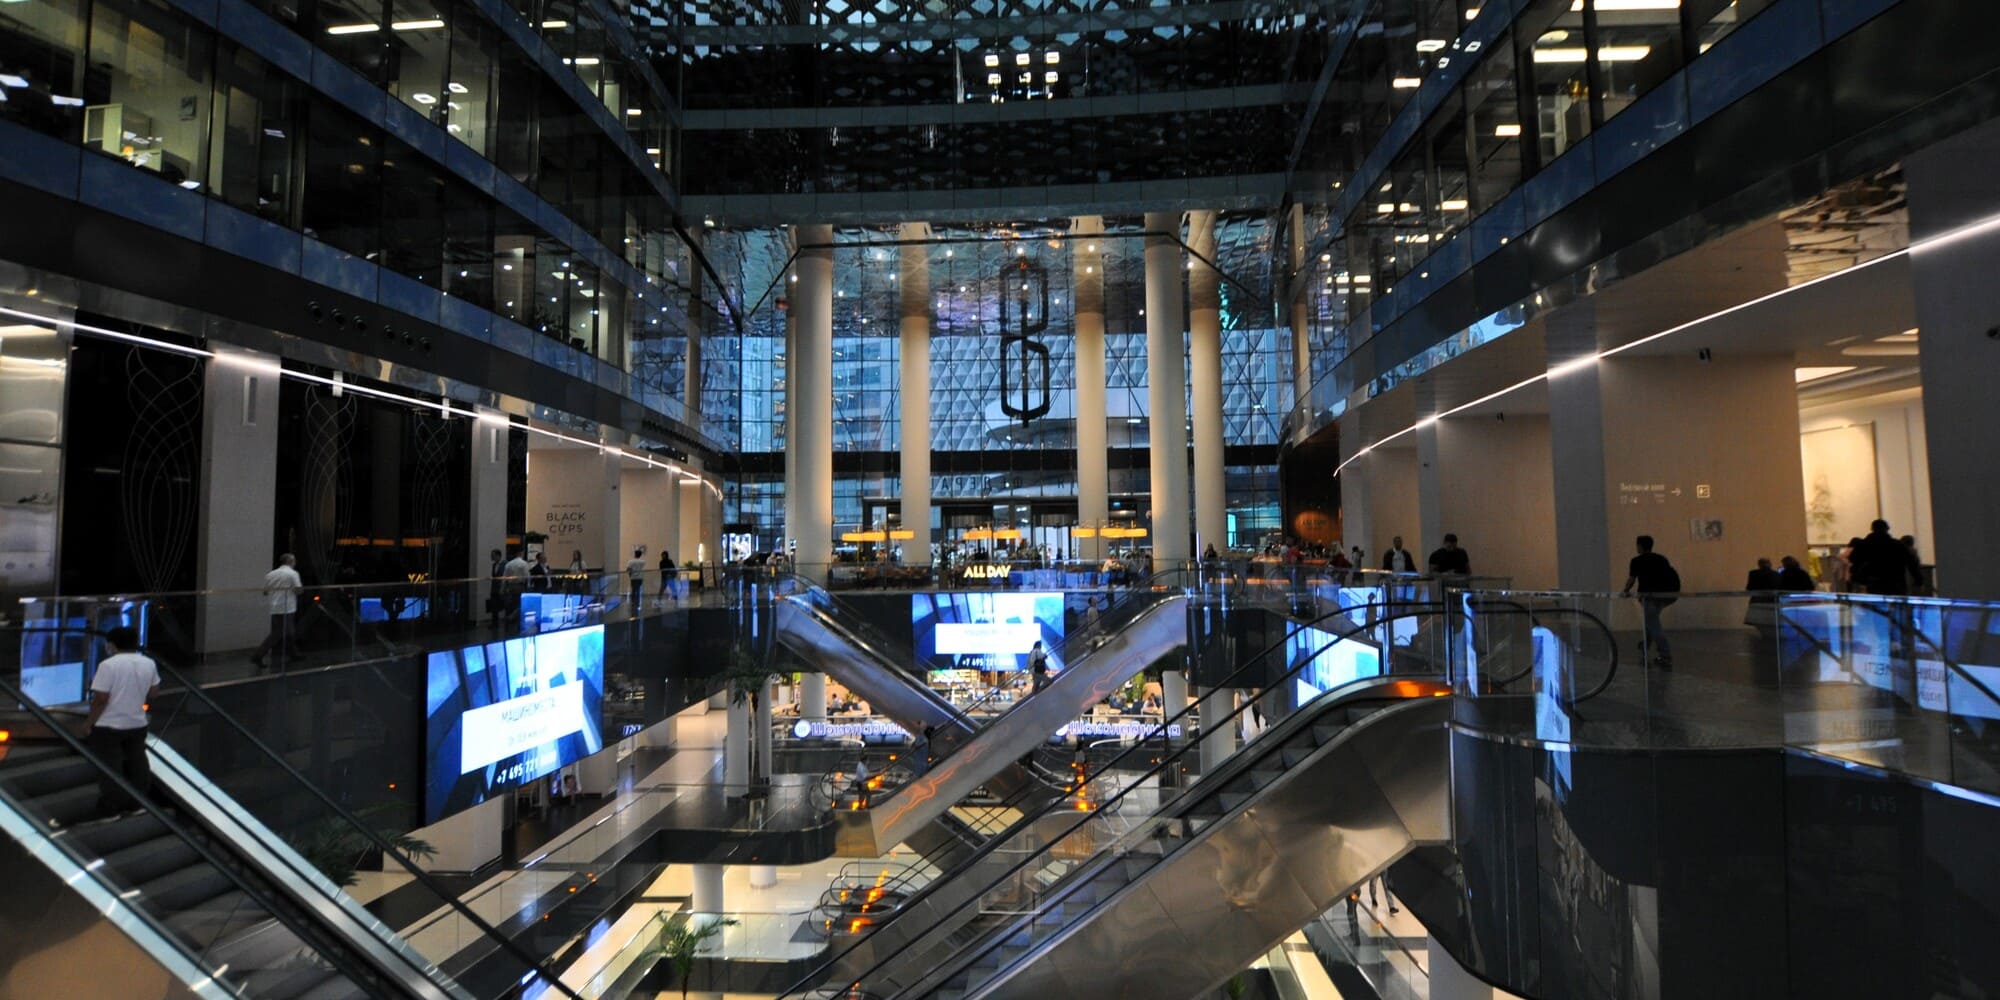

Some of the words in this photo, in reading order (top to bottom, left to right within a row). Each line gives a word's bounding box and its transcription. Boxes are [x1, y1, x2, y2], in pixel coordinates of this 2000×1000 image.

[546, 512, 586, 521] BLACK
[549, 524, 583, 533] CUPS
[963, 565, 985, 578] ALL
[986, 565, 1011, 578] DAY
[497, 769, 507, 784] +7
[509, 763, 523, 780] 495
